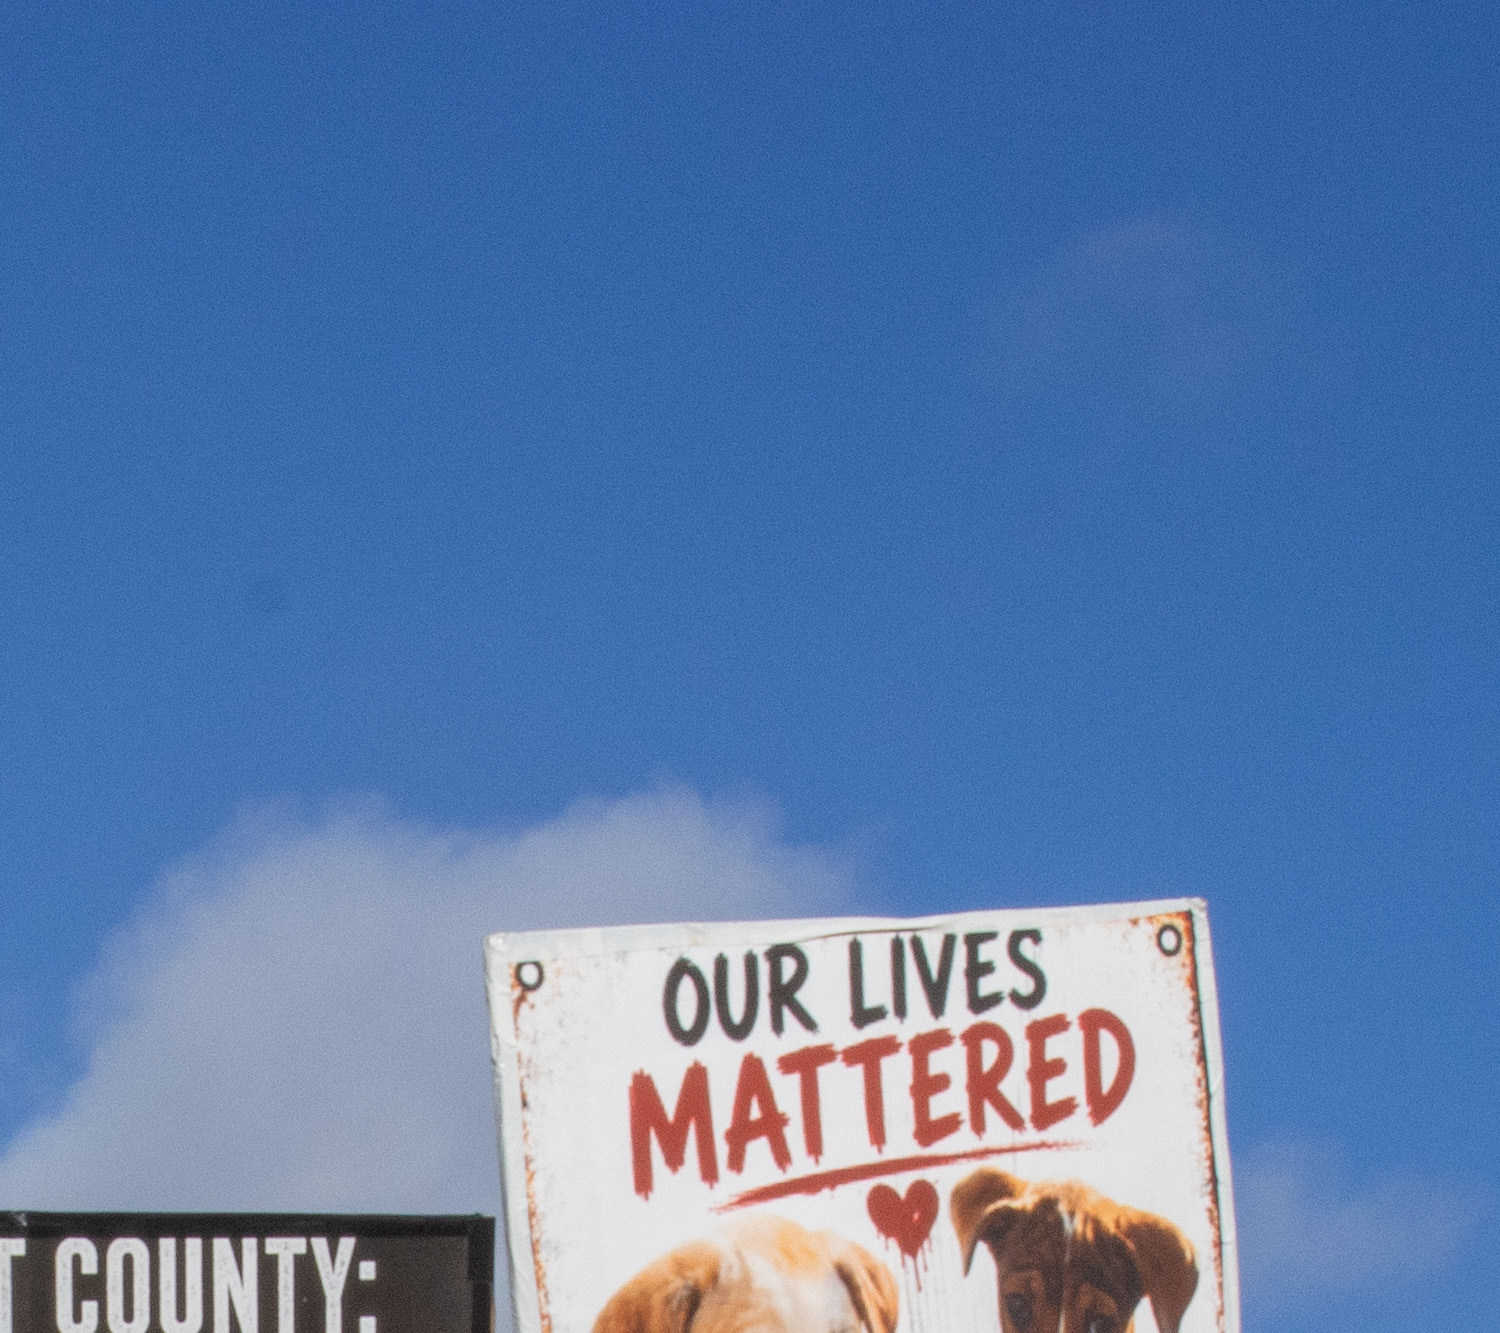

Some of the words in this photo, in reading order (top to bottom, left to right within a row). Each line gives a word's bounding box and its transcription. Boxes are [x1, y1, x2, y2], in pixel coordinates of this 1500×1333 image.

[663, 943, 818, 1046] OUR
[848, 929, 1046, 1030] LIVES
[628, 1007, 1136, 1201] MATTERED
